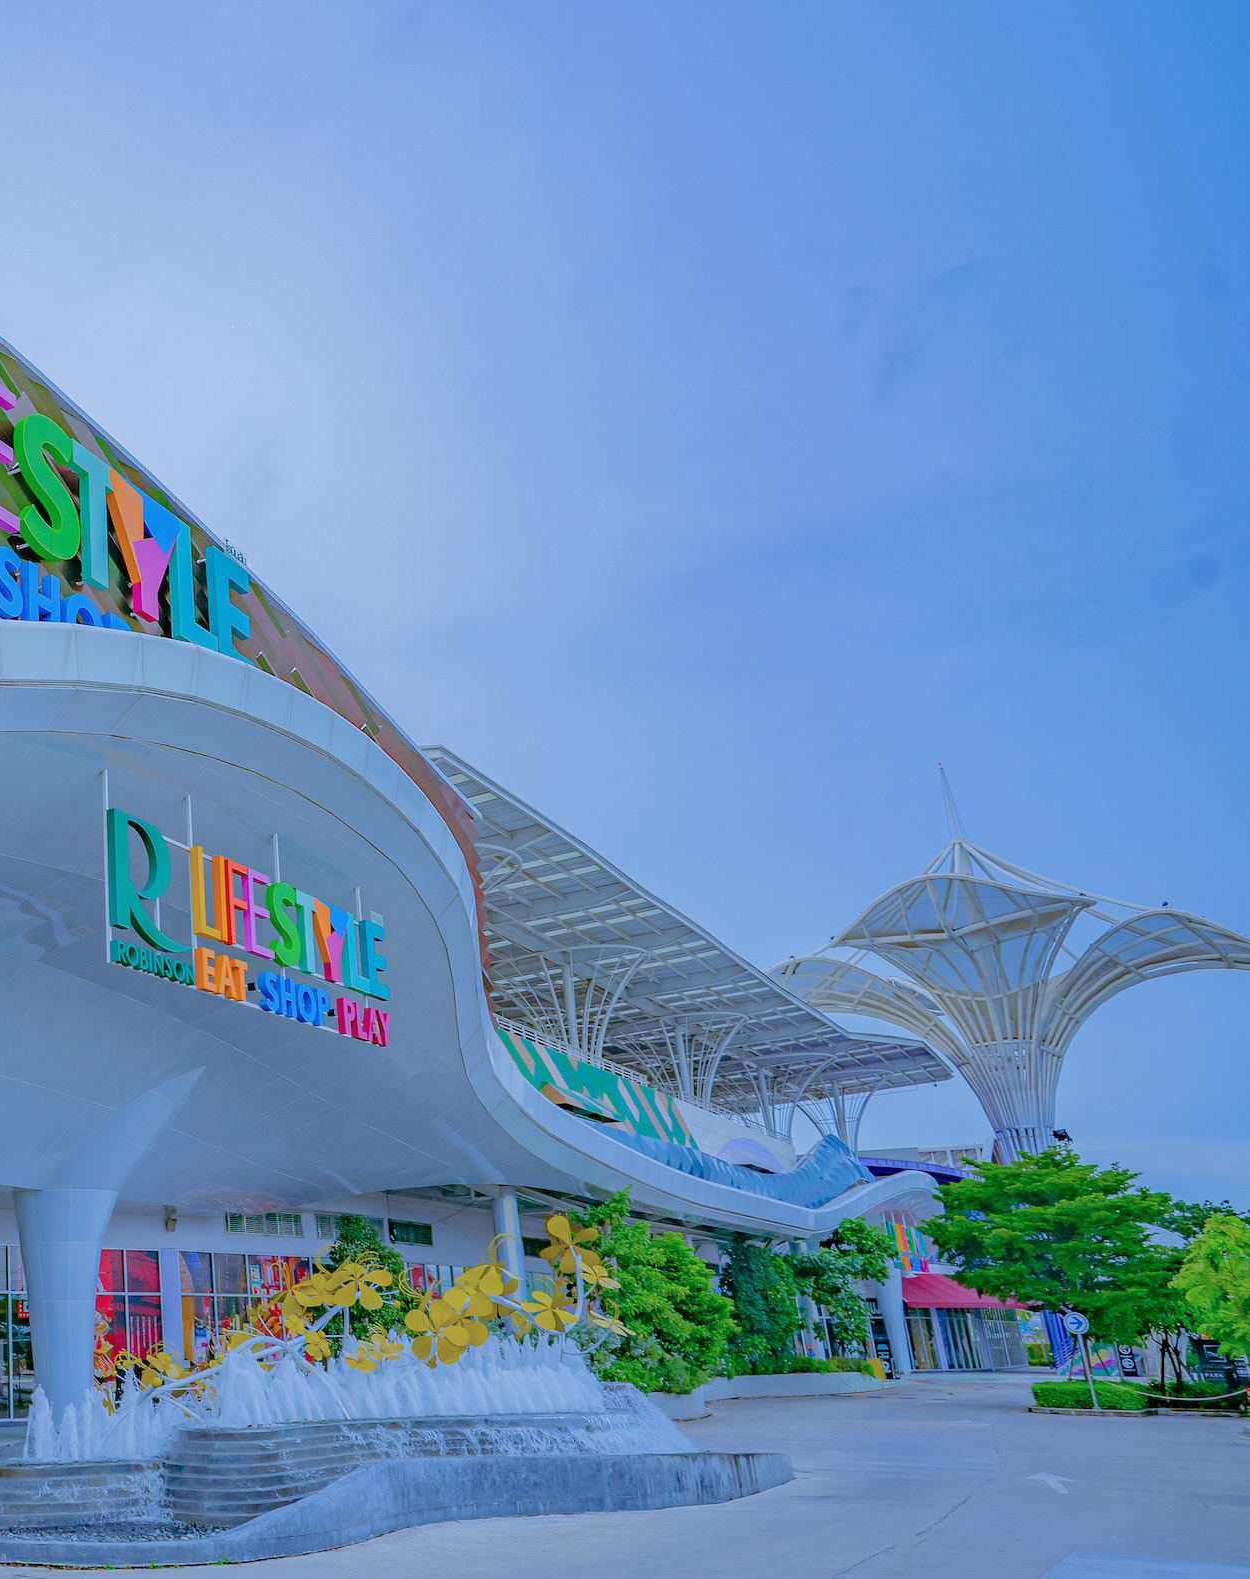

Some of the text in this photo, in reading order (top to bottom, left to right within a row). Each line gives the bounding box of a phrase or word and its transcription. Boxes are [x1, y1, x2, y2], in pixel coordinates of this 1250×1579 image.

[110, 940, 195, 986] ROBINSON
[191, 846, 390, 1000] LIFESTYLE
[194, 947, 391, 1047] EAT SHOP PLAY
